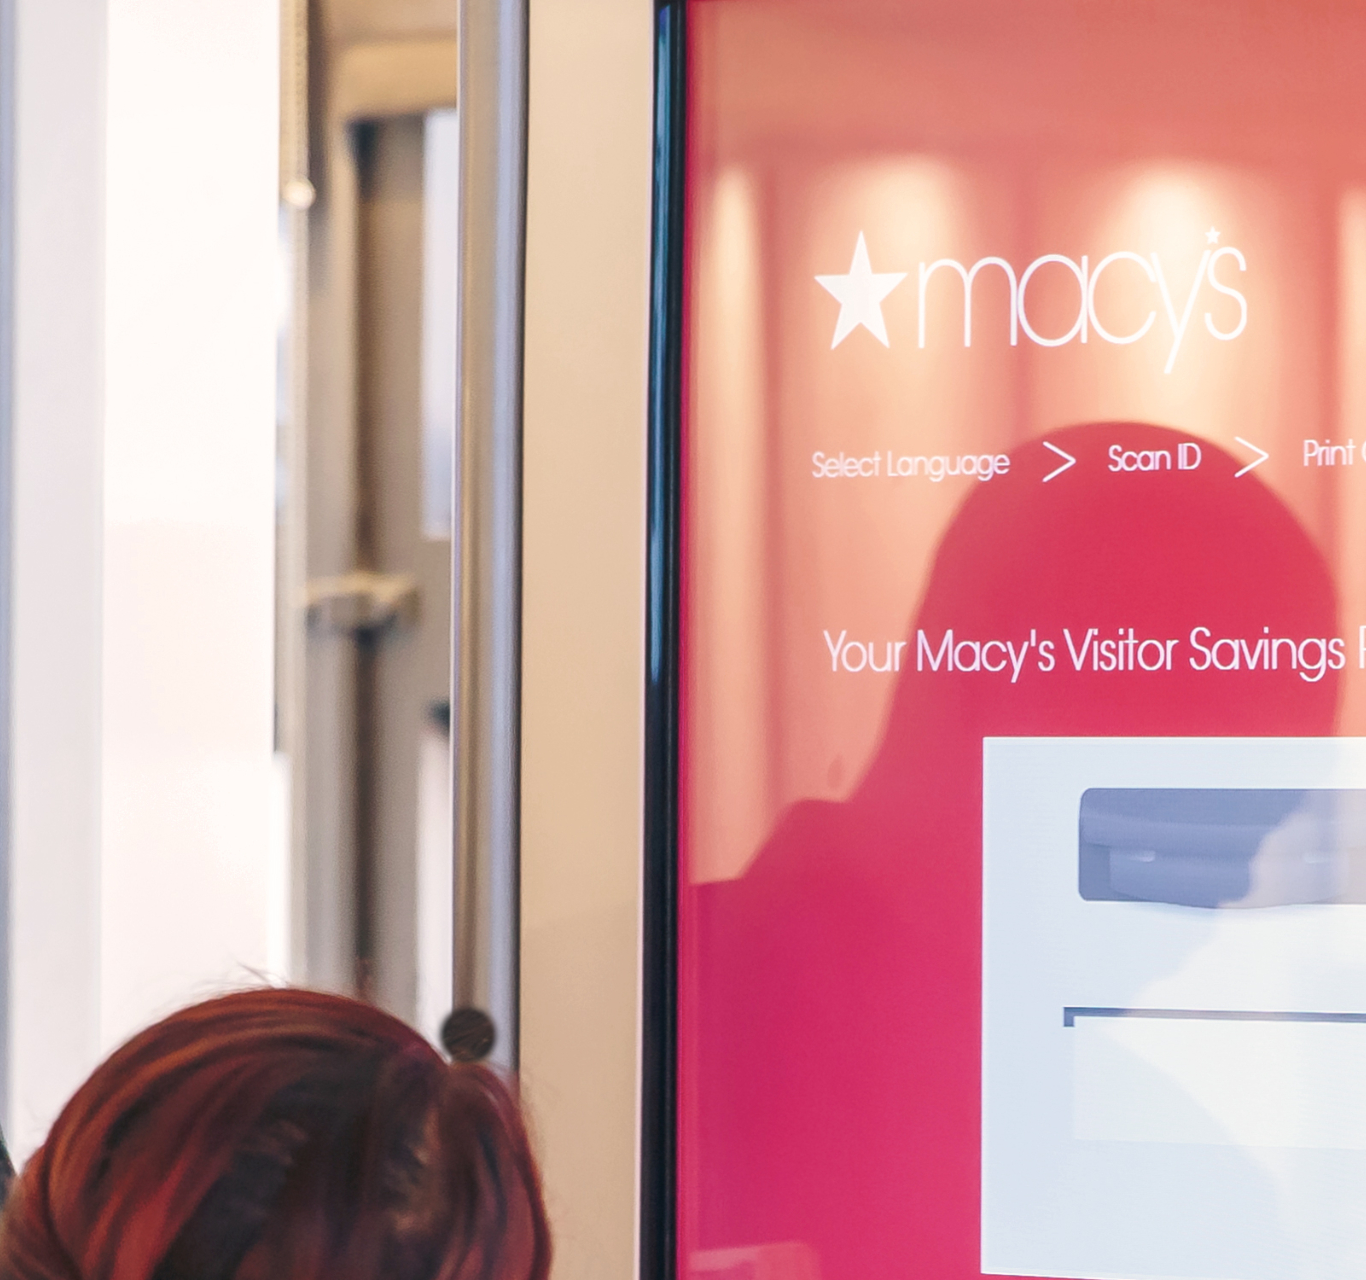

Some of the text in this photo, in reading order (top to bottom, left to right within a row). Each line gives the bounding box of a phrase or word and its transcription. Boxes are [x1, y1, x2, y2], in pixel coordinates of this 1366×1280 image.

[918, 226, 1248, 375] macy's
[811, 451, 882, 478] Select
[886, 451, 1011, 483] Language
[1108, 445, 1172, 473] Scan
[1177, 442, 1203, 471] ID
[1303, 438, 1357, 467] Print
[823, 630, 907, 673] Your
[916, 628, 1056, 683] Macy's
[1063, 627, 1180, 672] Visitor
[1188, 626, 1346, 682] Savings
